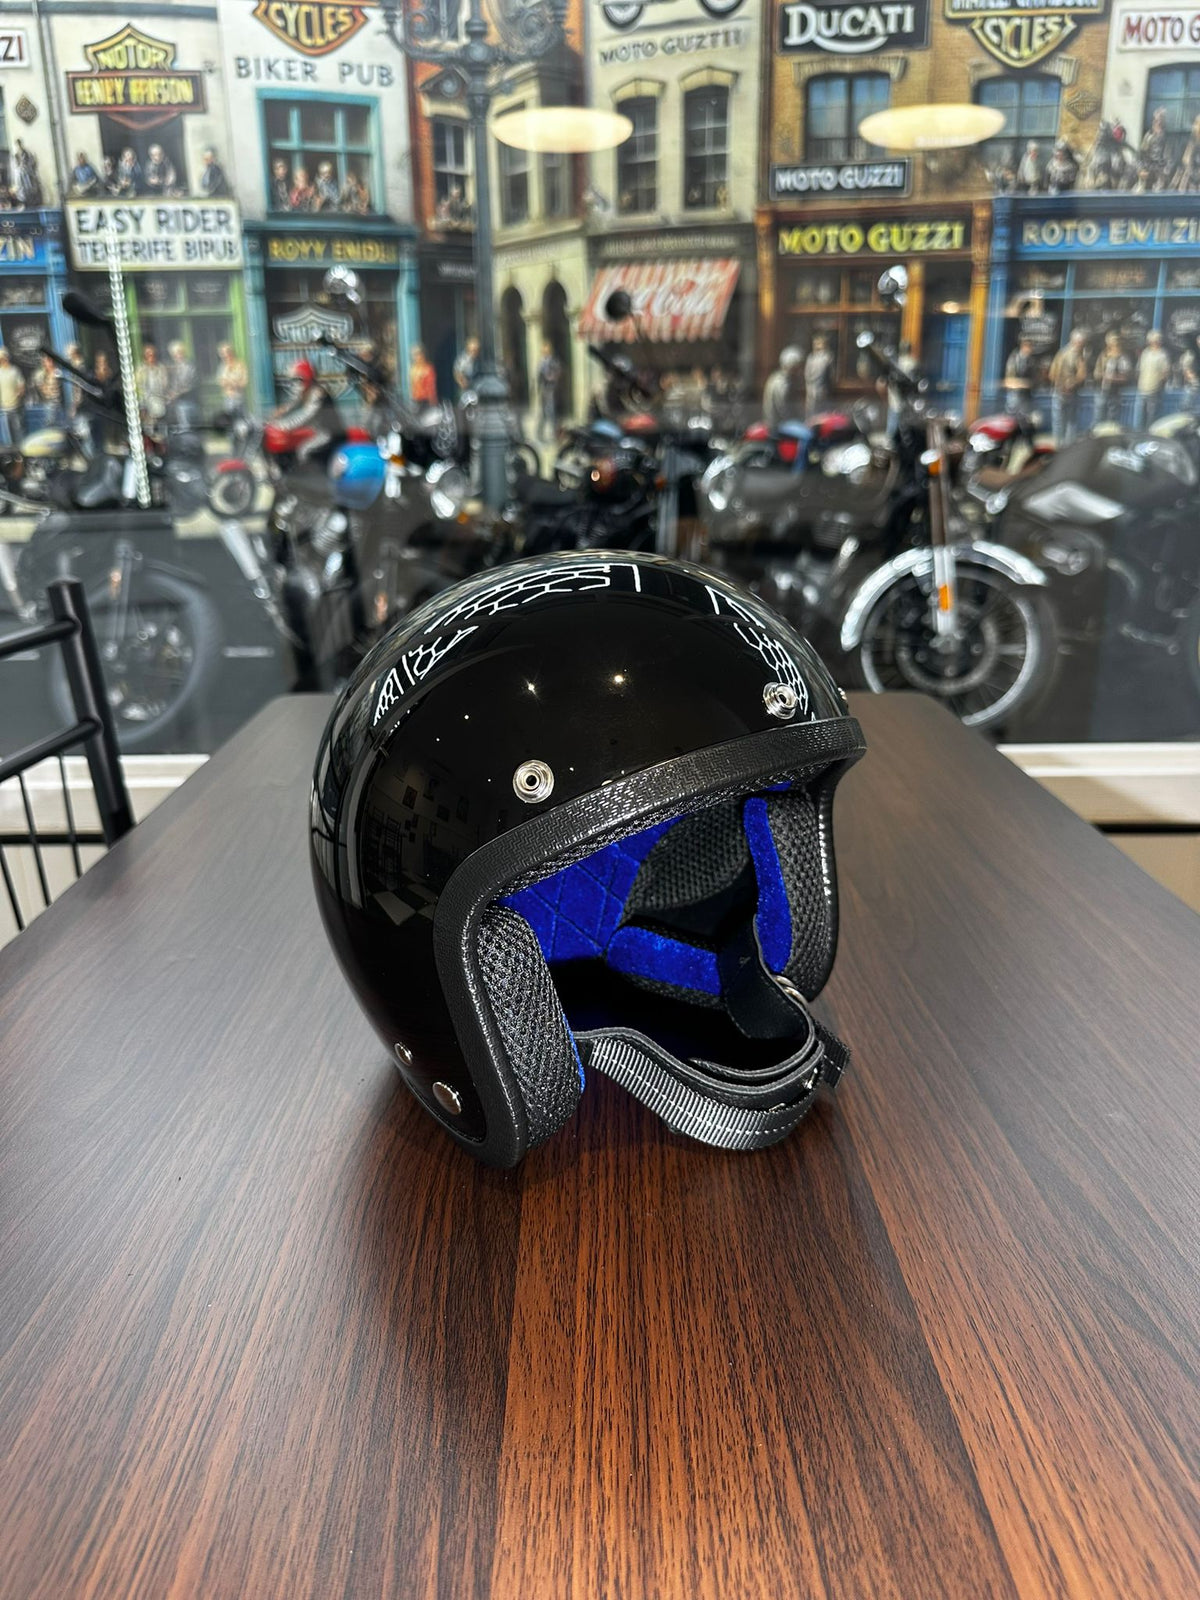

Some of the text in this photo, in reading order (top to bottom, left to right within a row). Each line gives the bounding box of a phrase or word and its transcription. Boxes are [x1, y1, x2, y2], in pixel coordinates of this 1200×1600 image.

[268, 2, 355, 47] CYCLES
[983, 16, 1063, 59] CYCLES
[1123, 15, 1184, 44] MOTO
[235, 56, 395, 87] BIKER PUB
[775, 164, 903, 192] MOTO GUZZI
[76, 208, 234, 235] EASY RIDER
[779, 221, 965, 254] MOTO GUZZI
